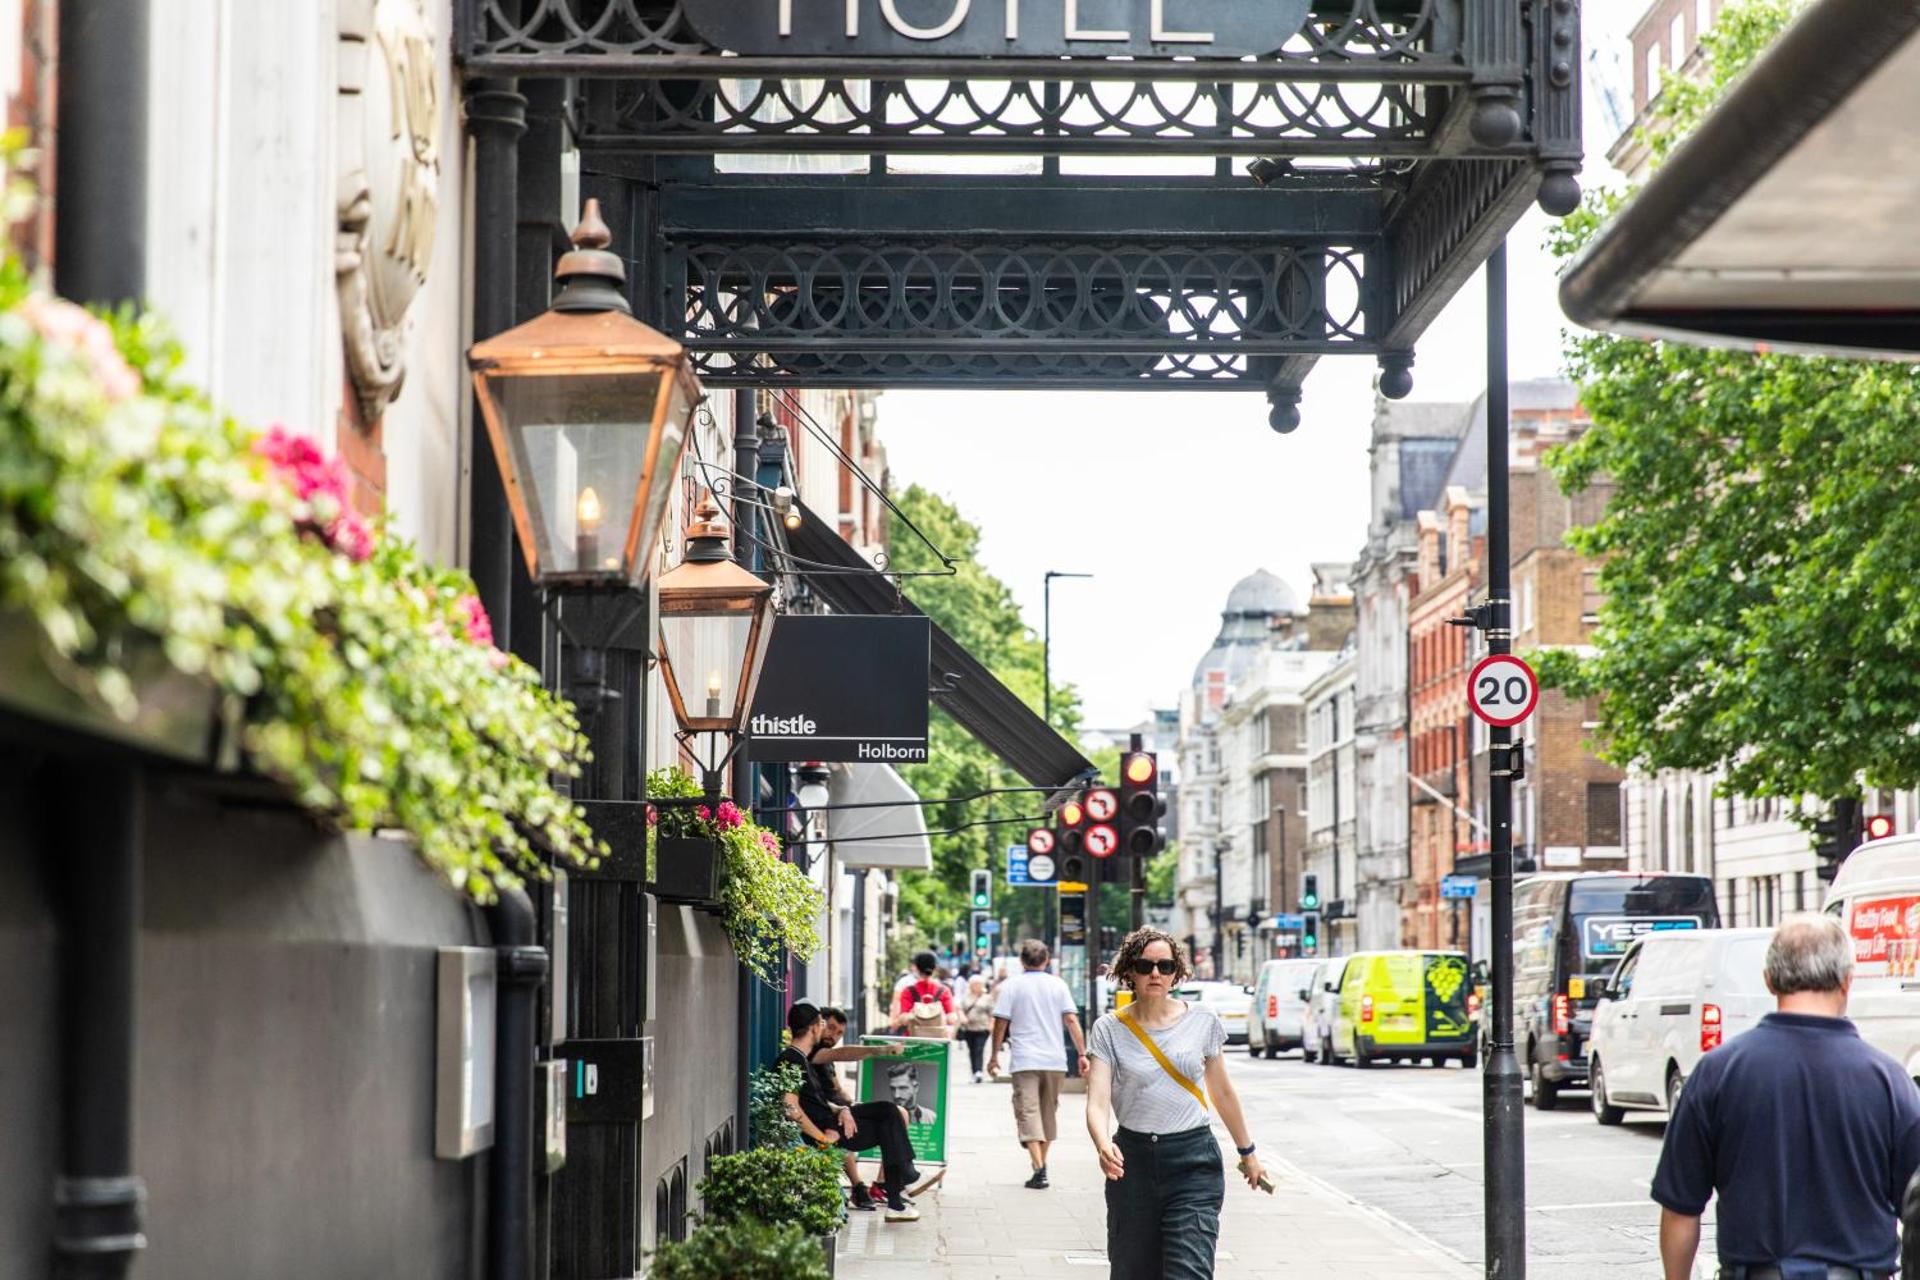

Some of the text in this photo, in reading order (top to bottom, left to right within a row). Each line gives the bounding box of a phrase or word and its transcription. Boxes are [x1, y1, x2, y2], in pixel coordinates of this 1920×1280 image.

[1479, 676, 1527, 705] 20
[751, 714, 816, 735] thistle
[858, 743, 925, 759] Holborn
